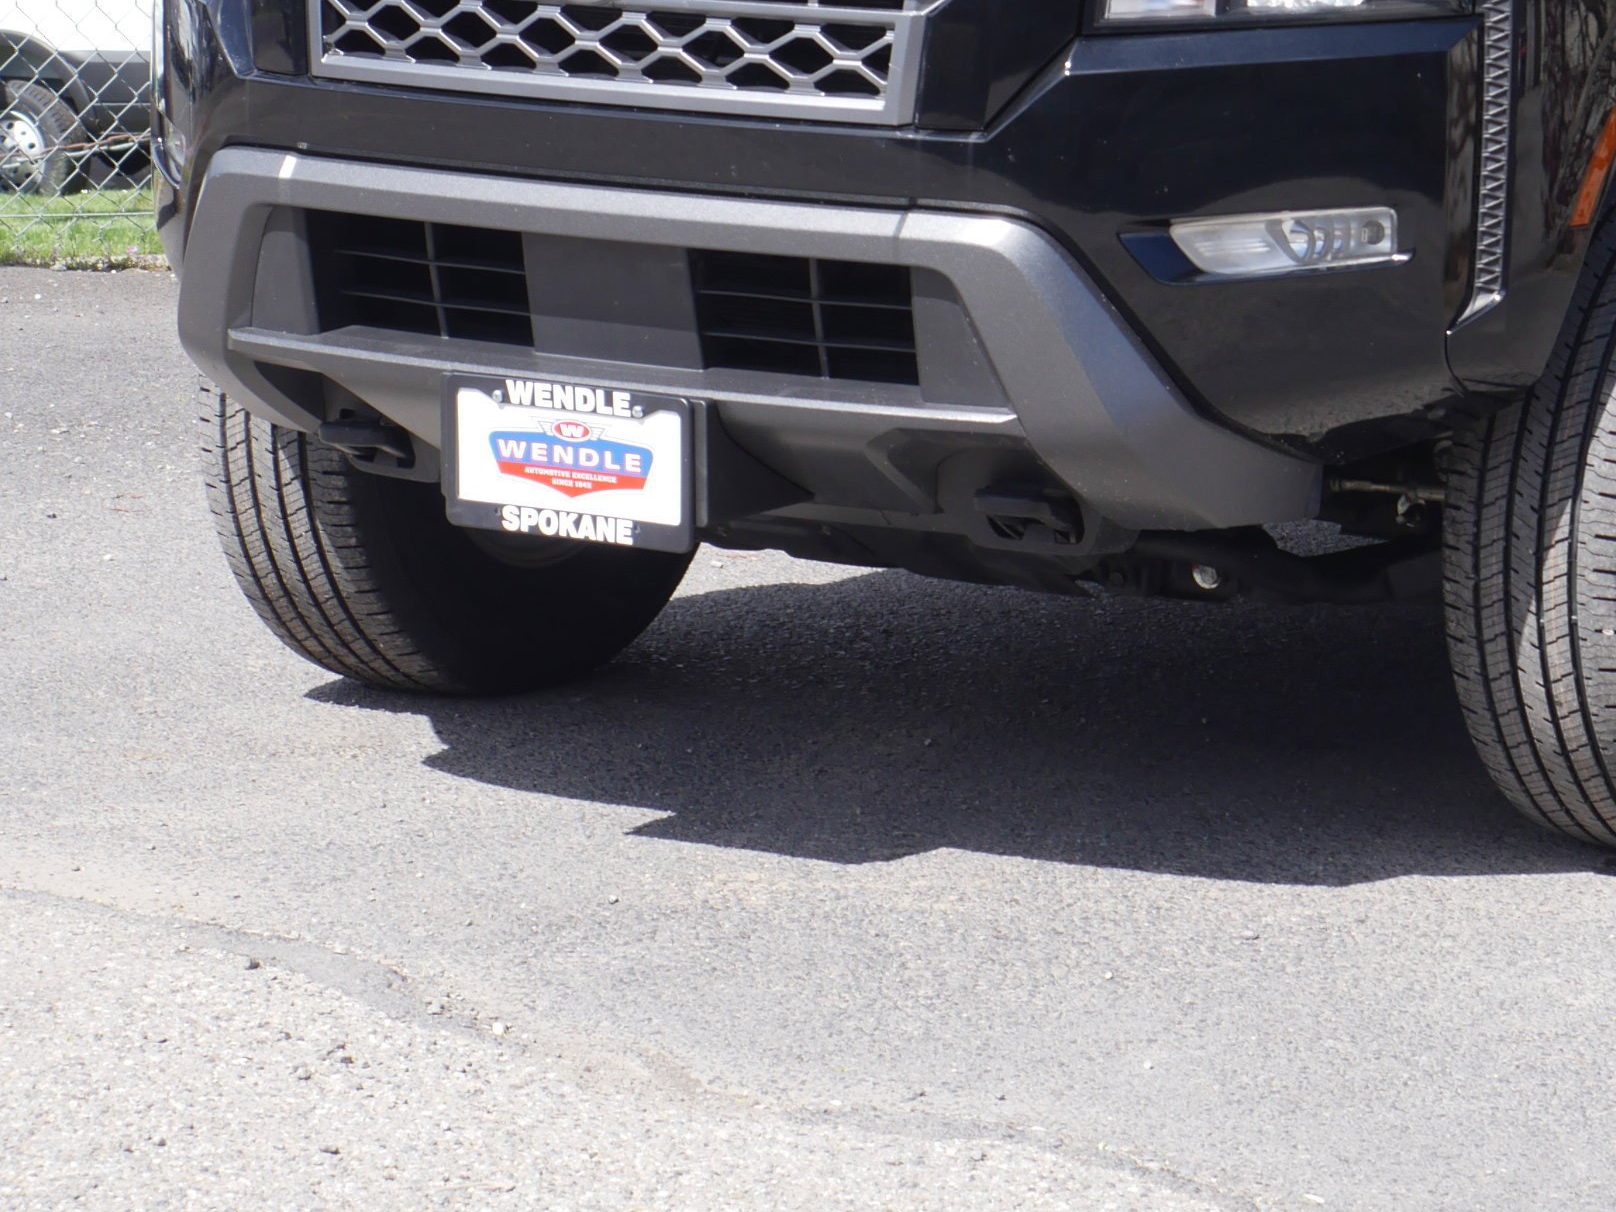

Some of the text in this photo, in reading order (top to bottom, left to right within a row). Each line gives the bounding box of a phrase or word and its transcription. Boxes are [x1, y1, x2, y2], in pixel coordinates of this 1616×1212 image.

[505, 379, 632, 418] WENDLE
[497, 438, 642, 473] WENDLE
[524, 466, 617, 484] AUTOMOTIVE EXCELLENCE
[551, 477, 573, 487] SINCE
[501, 504, 634, 546] SPOKANE
